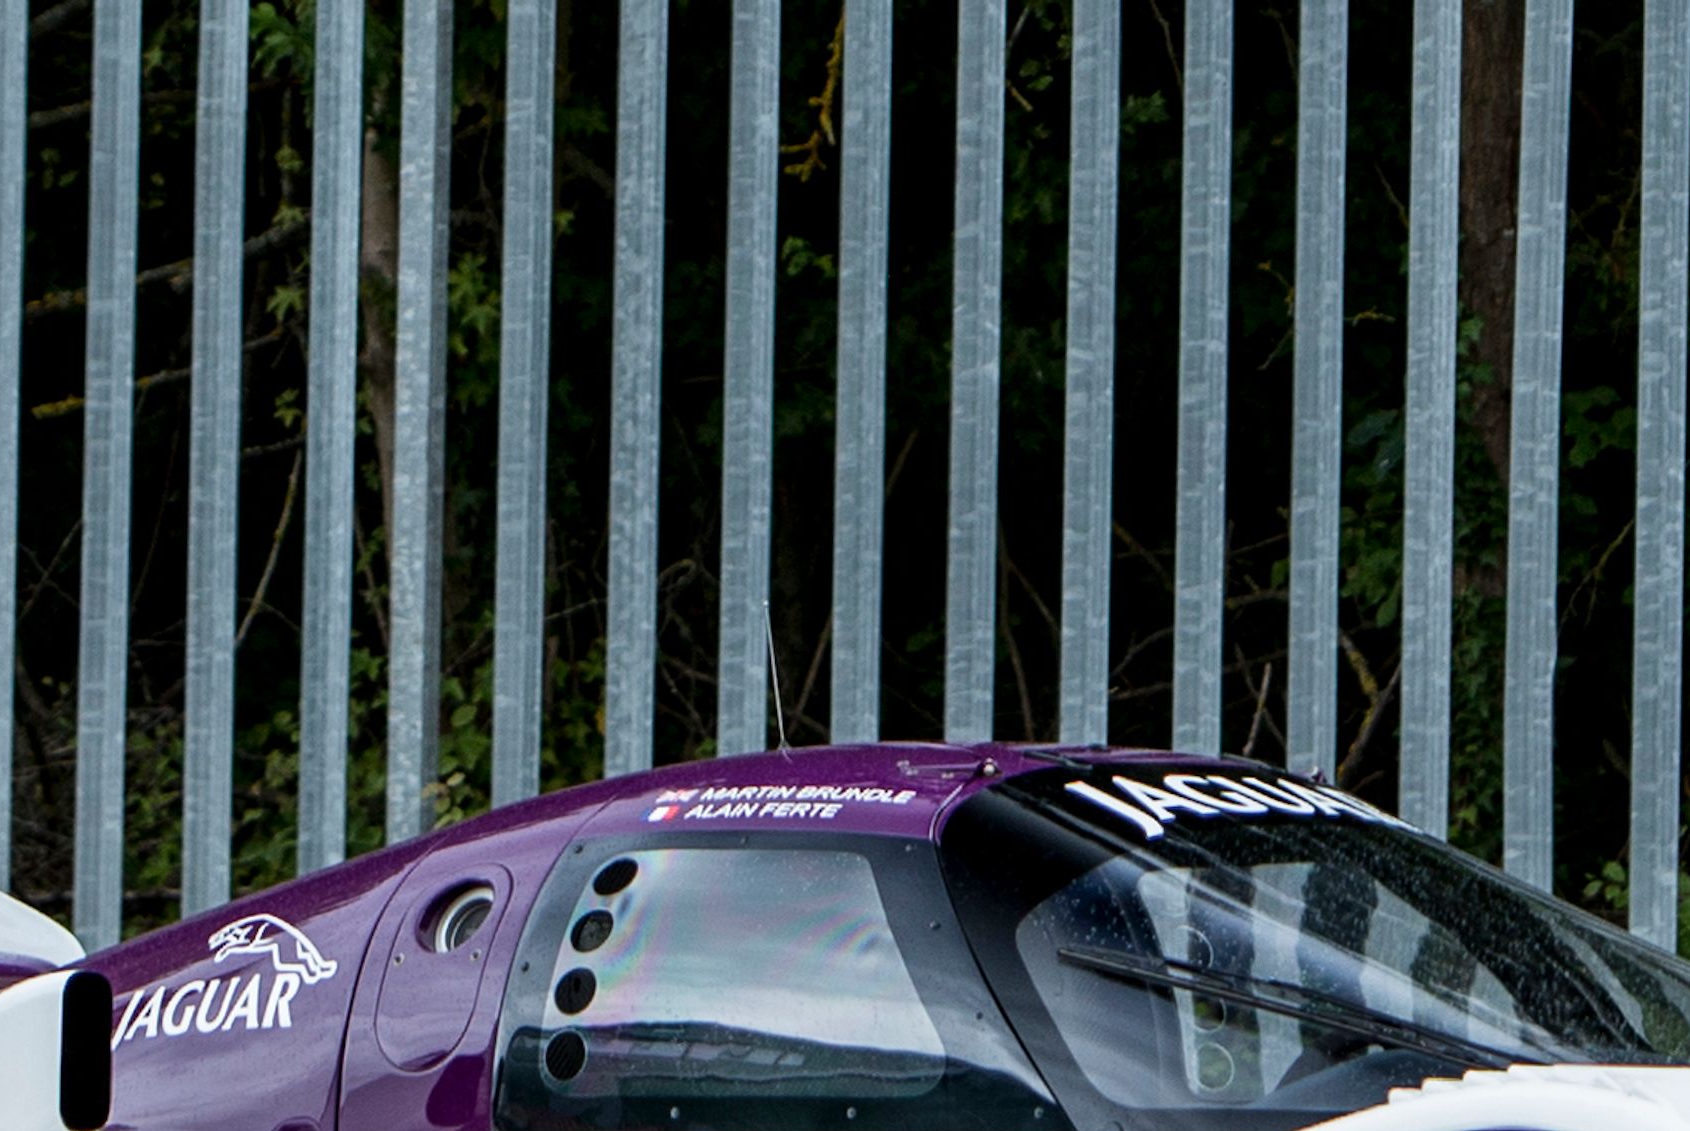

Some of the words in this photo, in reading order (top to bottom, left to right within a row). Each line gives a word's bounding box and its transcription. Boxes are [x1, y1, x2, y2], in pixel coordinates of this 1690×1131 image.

[700, 785, 797, 801] MARTIN
[796, 786, 917, 804] BRUNDLE
[684, 803, 758, 820] ALAIN
[759, 802, 843, 819] FERTE
[111, 973, 302, 1050] JAGUAR
